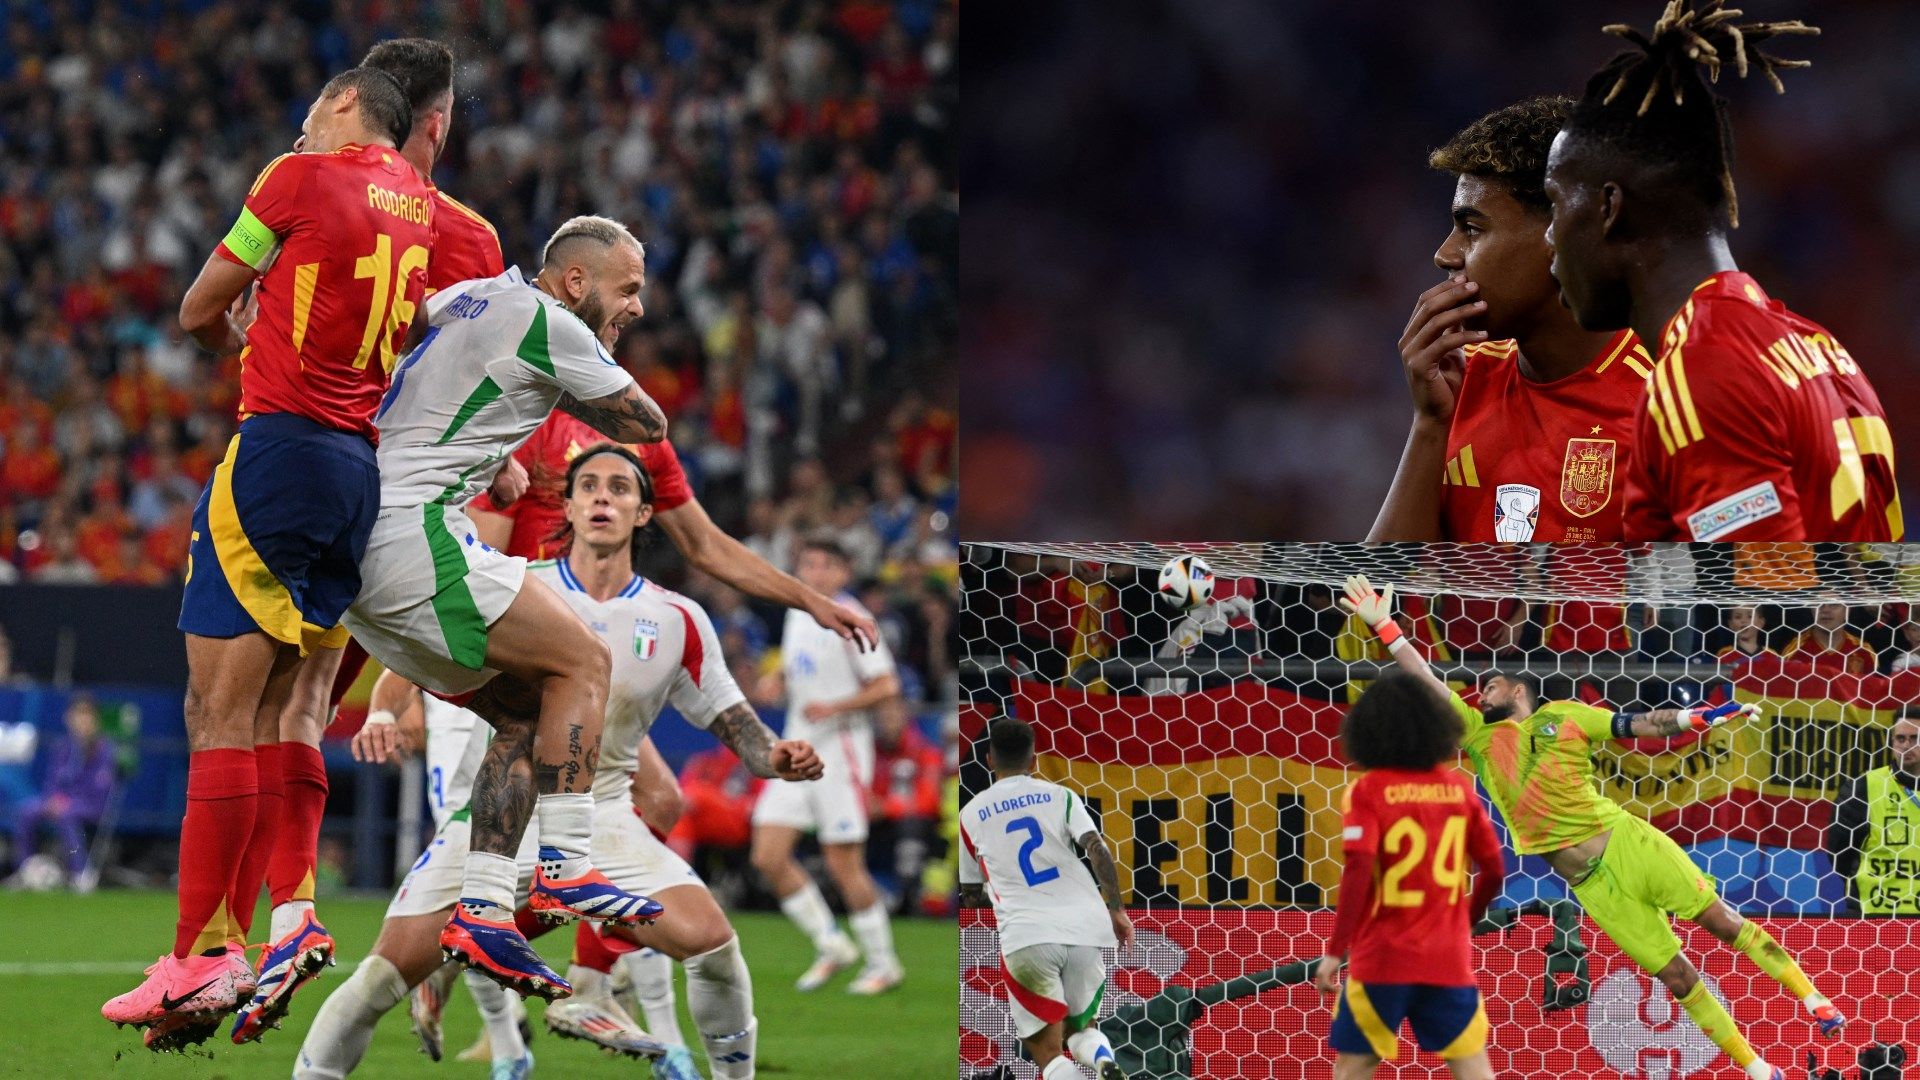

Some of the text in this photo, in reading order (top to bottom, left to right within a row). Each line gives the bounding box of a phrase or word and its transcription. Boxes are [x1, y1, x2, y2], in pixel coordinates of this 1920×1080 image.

[367, 183, 429, 227] RODRIGO
[352, 233, 429, 375] 16
[1693, 493, 1776, 534] FOUNDATION
[978, 793, 1051, 821] DI LORENZO
[1006, 816, 1060, 887] 2
[1383, 816, 1468, 907] 24
